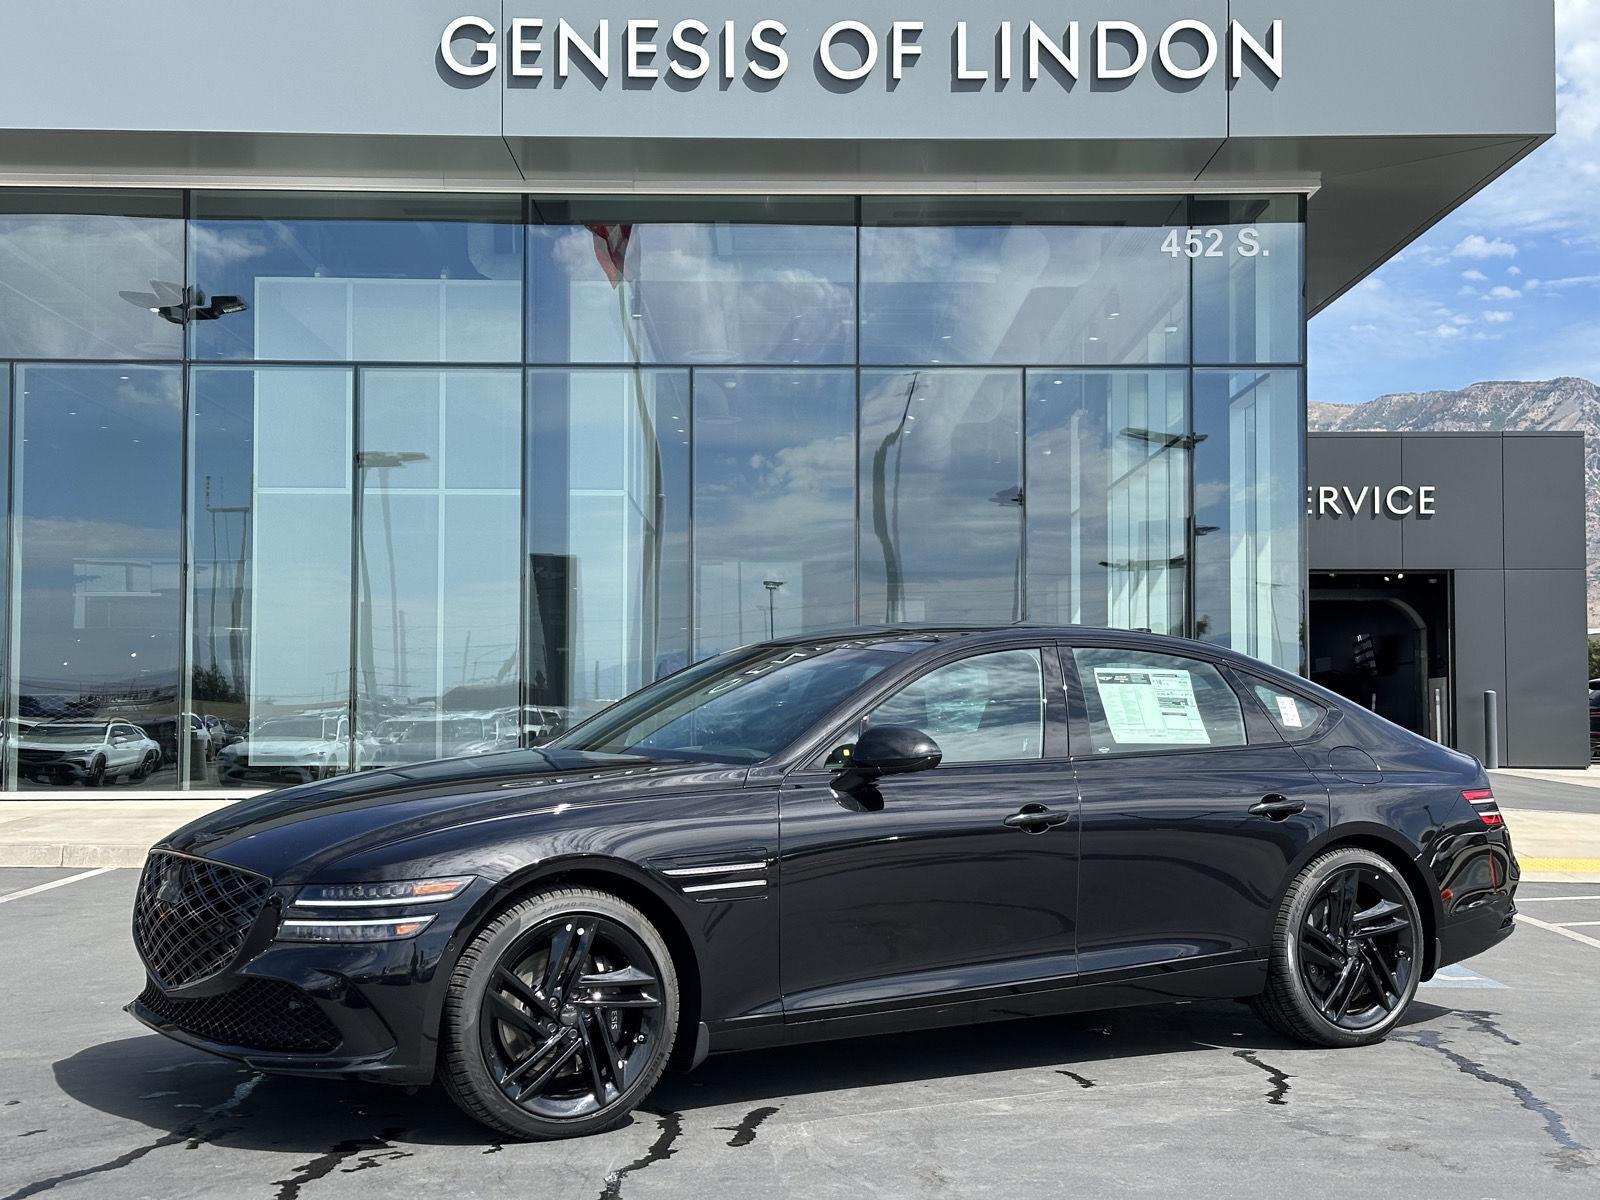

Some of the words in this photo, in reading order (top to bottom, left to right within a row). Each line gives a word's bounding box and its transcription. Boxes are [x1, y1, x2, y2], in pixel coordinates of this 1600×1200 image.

[440, 15, 790, 79] GENESIS
[820, 20, 925, 80] OF
[956, 19, 1283, 79] LINDON
[1160, 228, 1224, 258] 452
[1237, 227, 1270, 257] S.
[1307, 485, 1436, 515] RVICE
